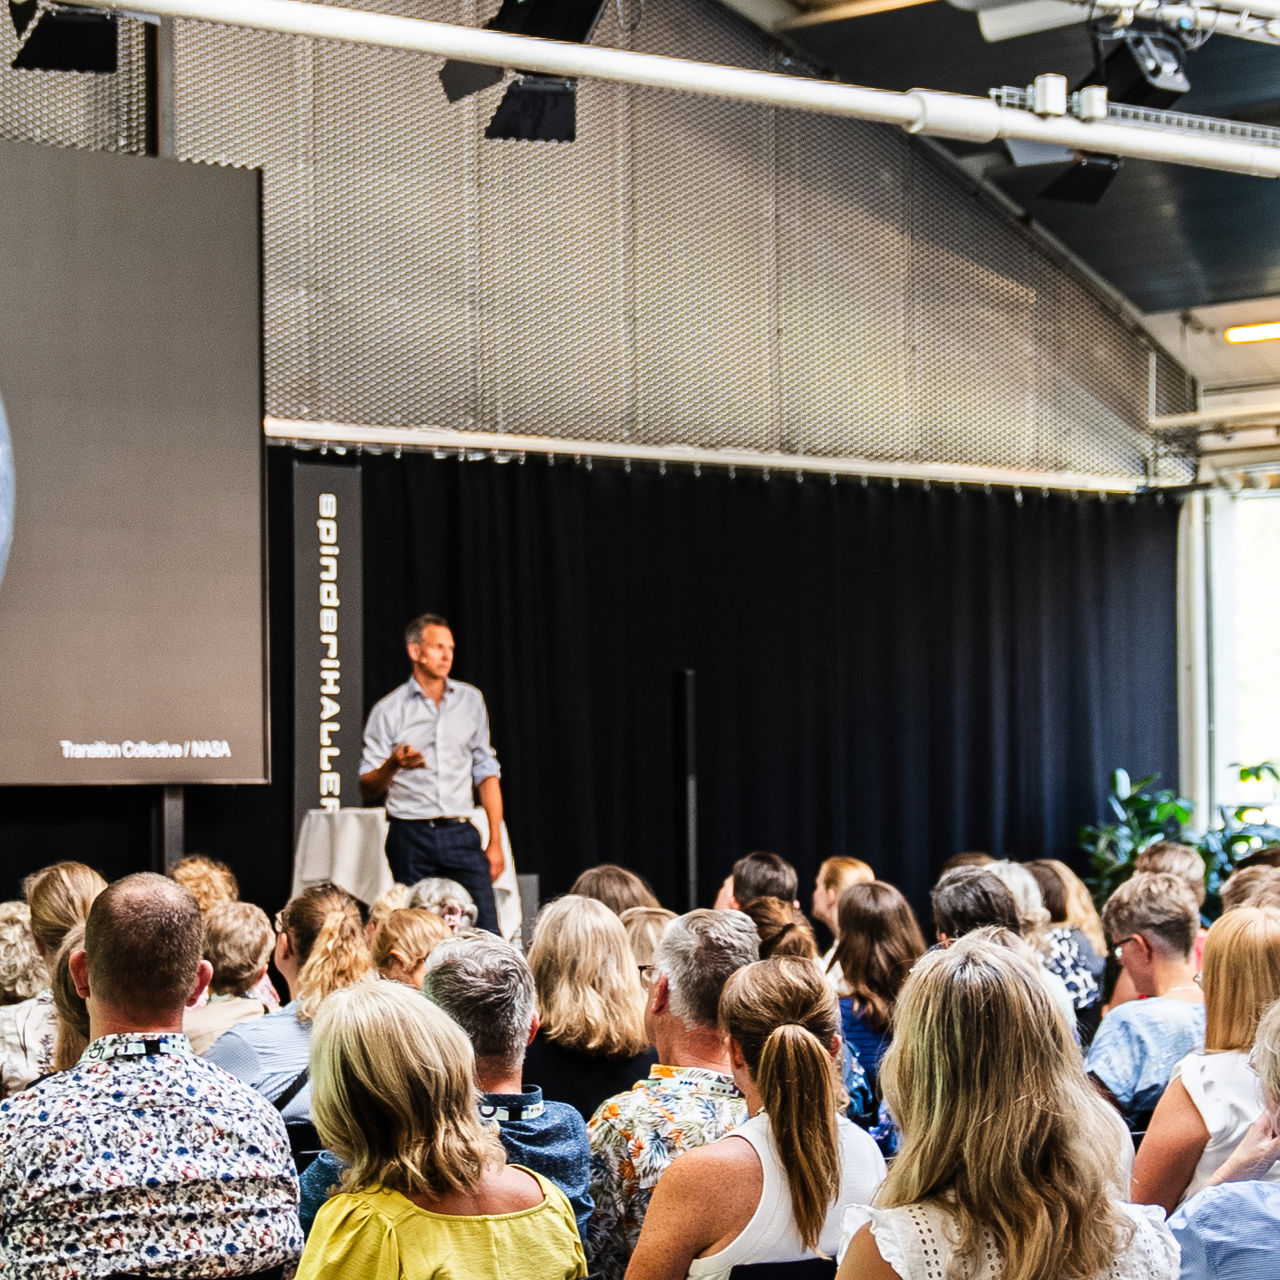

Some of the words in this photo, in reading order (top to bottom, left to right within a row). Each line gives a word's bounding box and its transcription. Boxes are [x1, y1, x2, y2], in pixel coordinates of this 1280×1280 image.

[60, 740, 120, 758] Transition
[122, 740, 182, 758] Collective
[192, 740, 231, 758] NASA
